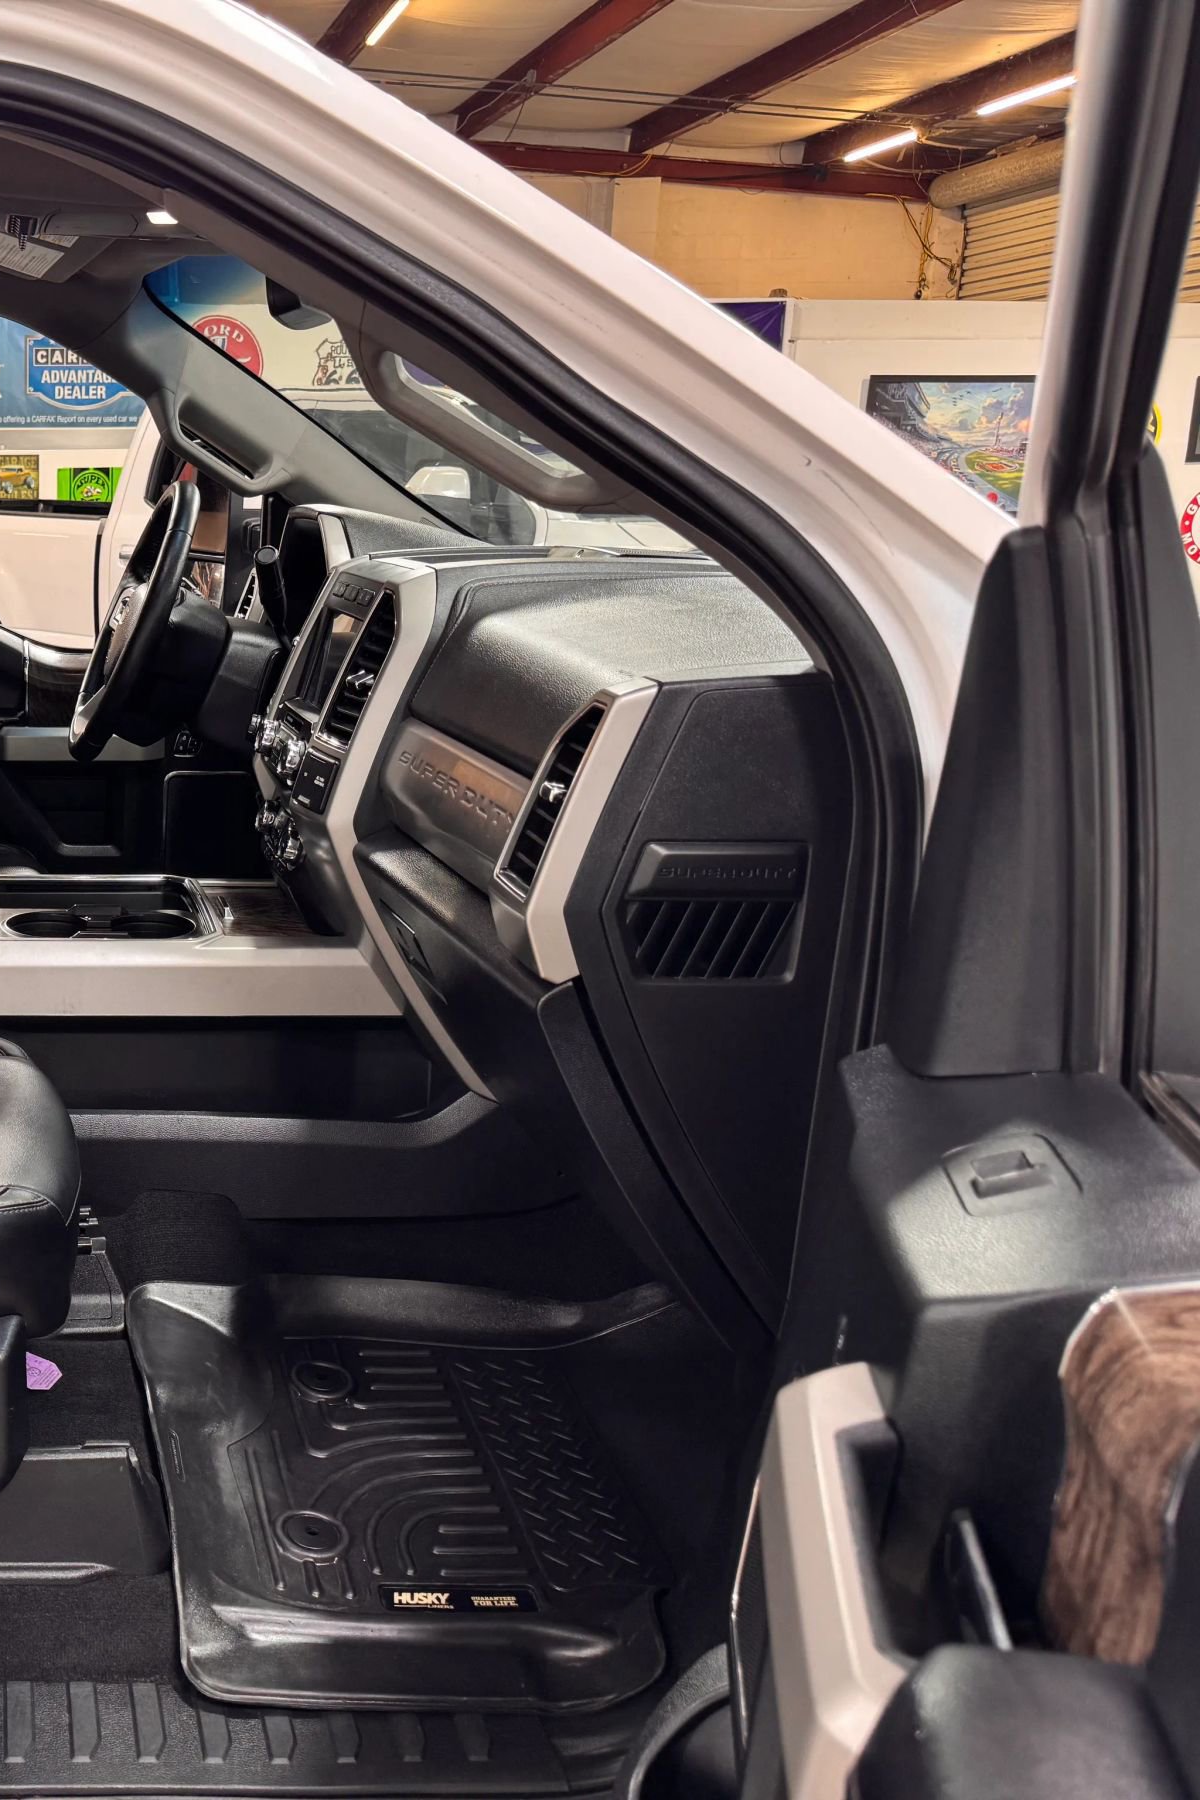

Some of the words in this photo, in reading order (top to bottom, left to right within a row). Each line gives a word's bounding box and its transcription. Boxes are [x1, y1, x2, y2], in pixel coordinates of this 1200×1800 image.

[204, 325, 244, 342] ORD
[37, 350, 87, 363] CAR
[41, 370, 117, 383] ADVANTAG
[55, 386, 106, 399] DEALER
[398, 751, 460, 798] SUPER
[393, 1592, 450, 1604] HUSKY
